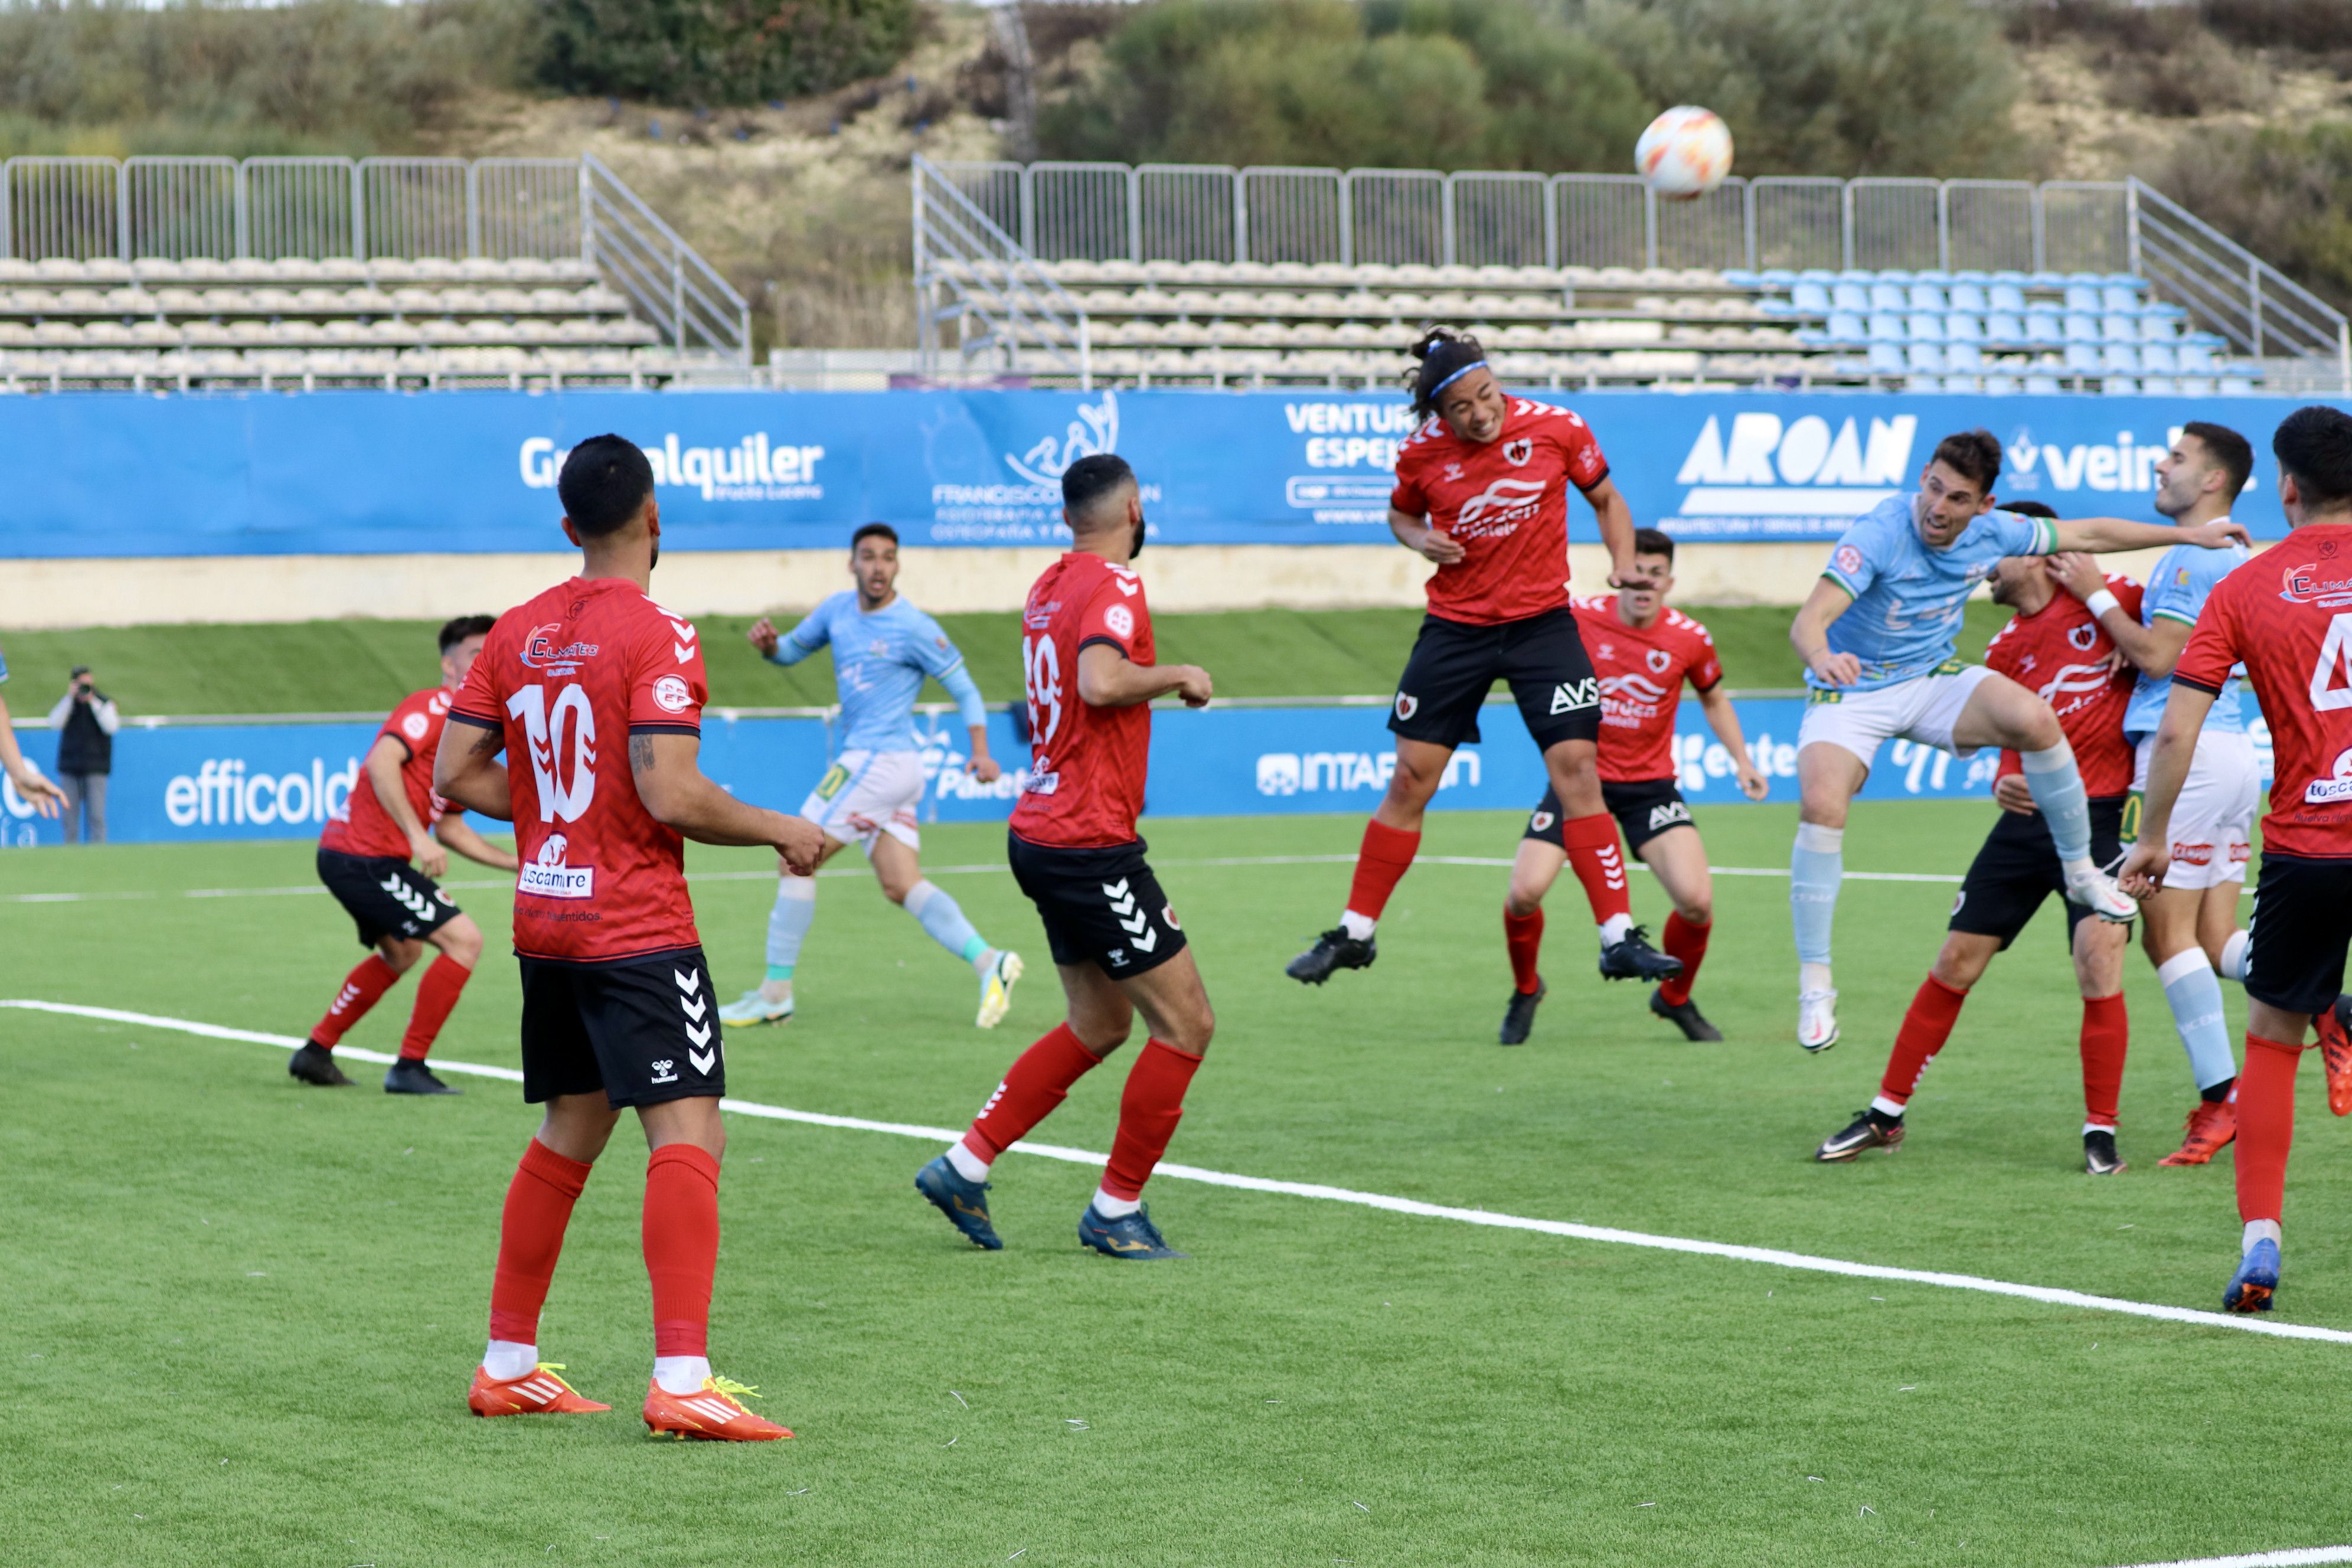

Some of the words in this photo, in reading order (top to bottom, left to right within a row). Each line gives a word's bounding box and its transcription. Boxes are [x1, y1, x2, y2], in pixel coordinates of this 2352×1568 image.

[1675, 411, 1919, 486] AROAN
[1550, 677, 1600, 716] AVS
[2309, 612, 2352, 712] 4
[505, 682, 596, 824] 10
[651, 1073, 678, 1084] hummel
